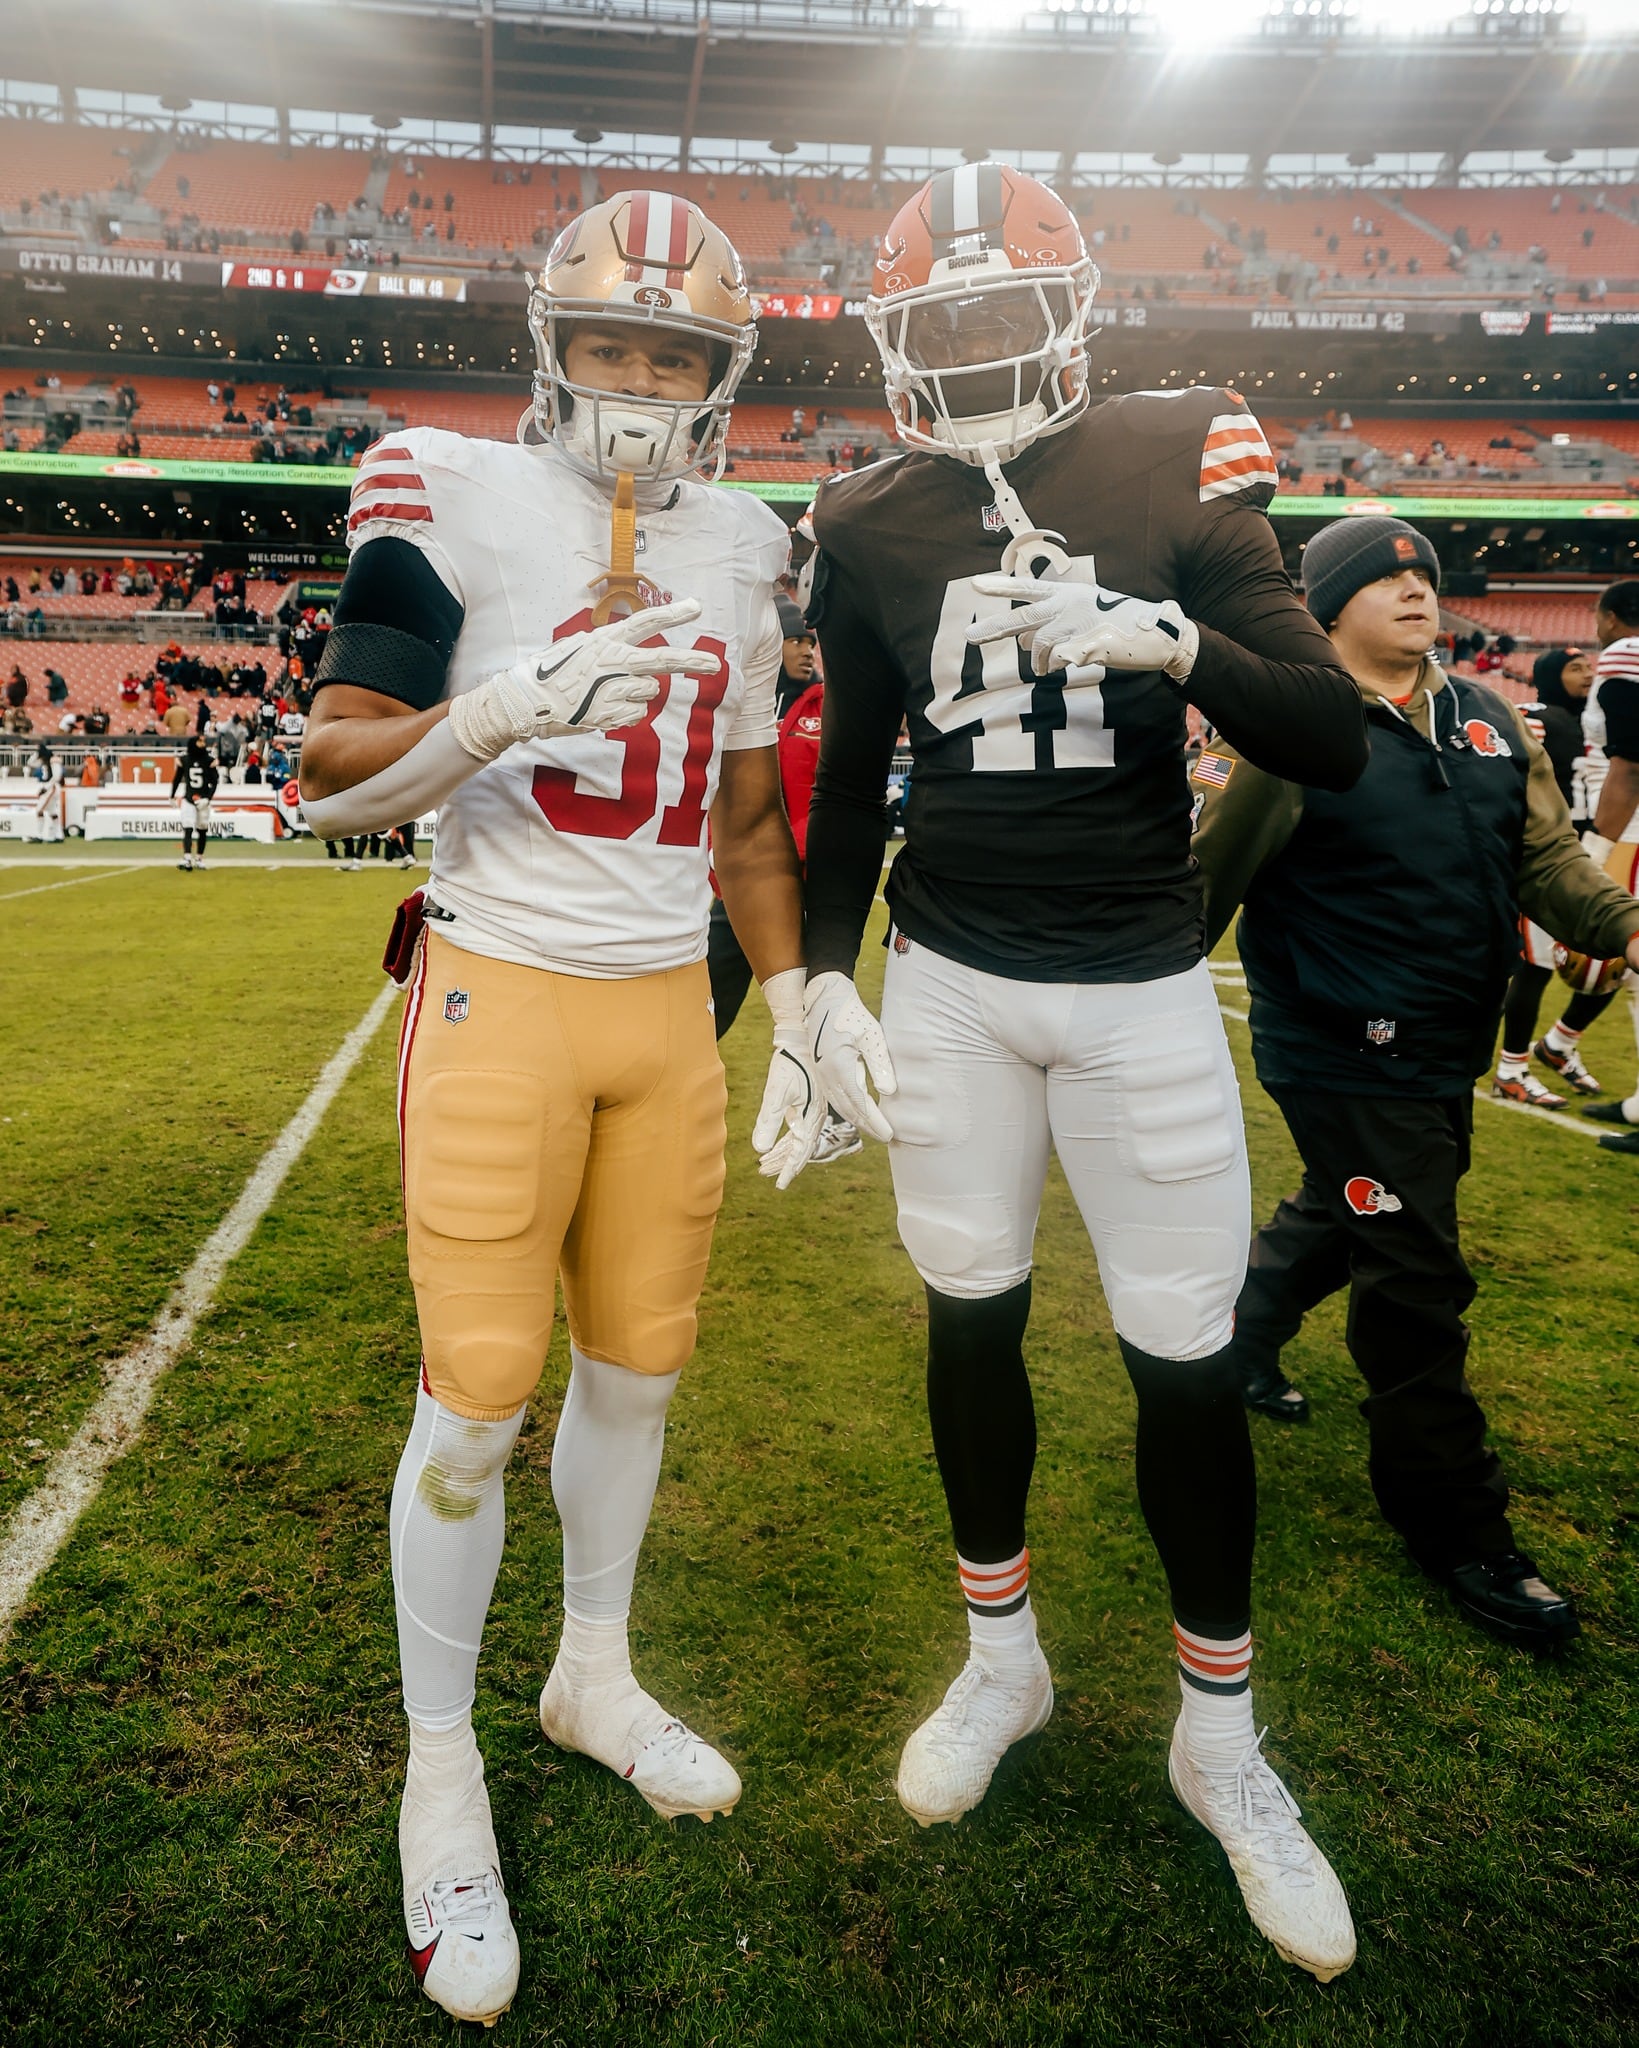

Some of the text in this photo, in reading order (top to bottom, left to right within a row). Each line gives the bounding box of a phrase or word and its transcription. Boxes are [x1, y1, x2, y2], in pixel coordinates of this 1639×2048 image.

[19, 251, 183, 282] OTTO GRAHAM 14
[948, 253, 989, 270] BROWNS
[247, 268, 272, 287] 2ND
[379, 275, 405, 294] BALL
[1124, 307, 1147, 327] 32
[1251, 311, 1405, 332] PAUL WARFIELD 42
[248, 552, 317, 564] WELCOME TO
[923, 554, 1117, 772] 41
[287, 719, 300, 728] 95
[532, 607, 729, 848] 31
[189, 767, 204, 788] 5
[121, 820, 184, 833] CLEVELAND
[447, 1004, 464, 1018] NFL
[1371, 1031, 1389, 1040] NFL
